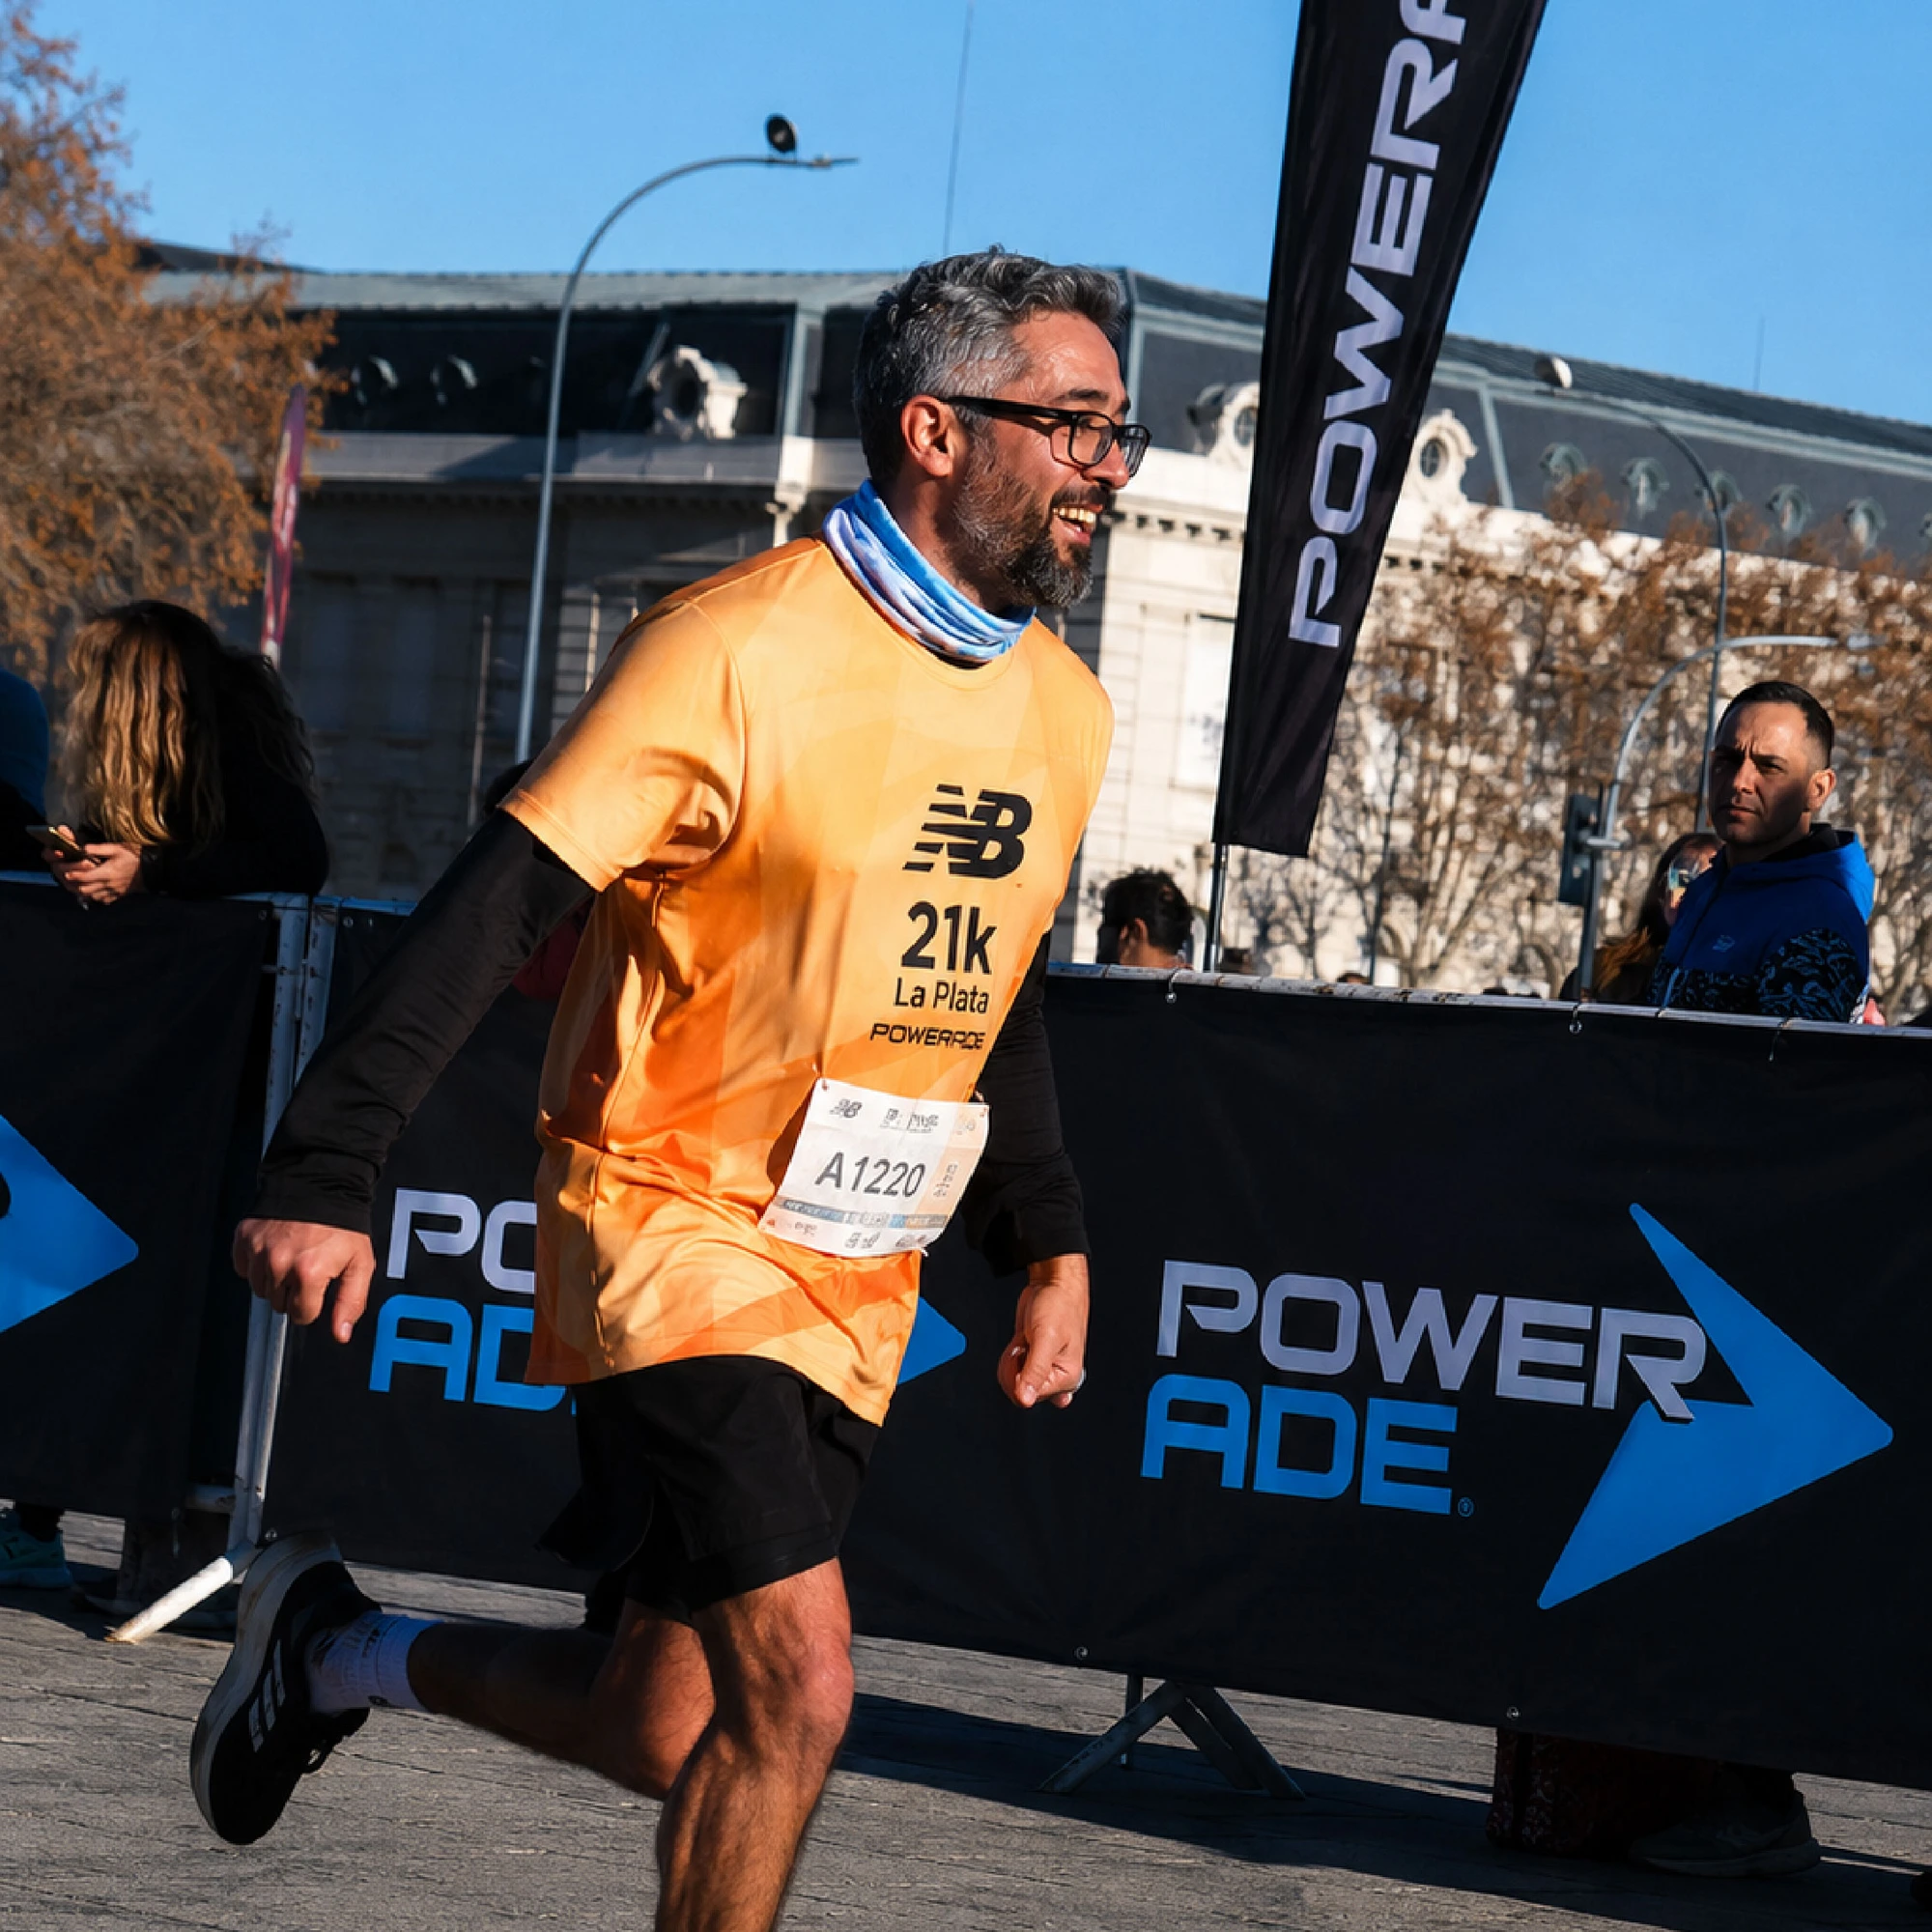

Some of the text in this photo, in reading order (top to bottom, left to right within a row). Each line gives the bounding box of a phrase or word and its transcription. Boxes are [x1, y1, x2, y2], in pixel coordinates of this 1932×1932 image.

[900, 901, 998, 975] 21k
[894, 978, 989, 1013] La Plata
[814, 1151, 927, 1198] A1220
[368, 1293, 577, 1415] AD
[1157, 1260, 1708, 1420] POWER
[1141, 1373, 1459, 1516] ADE
